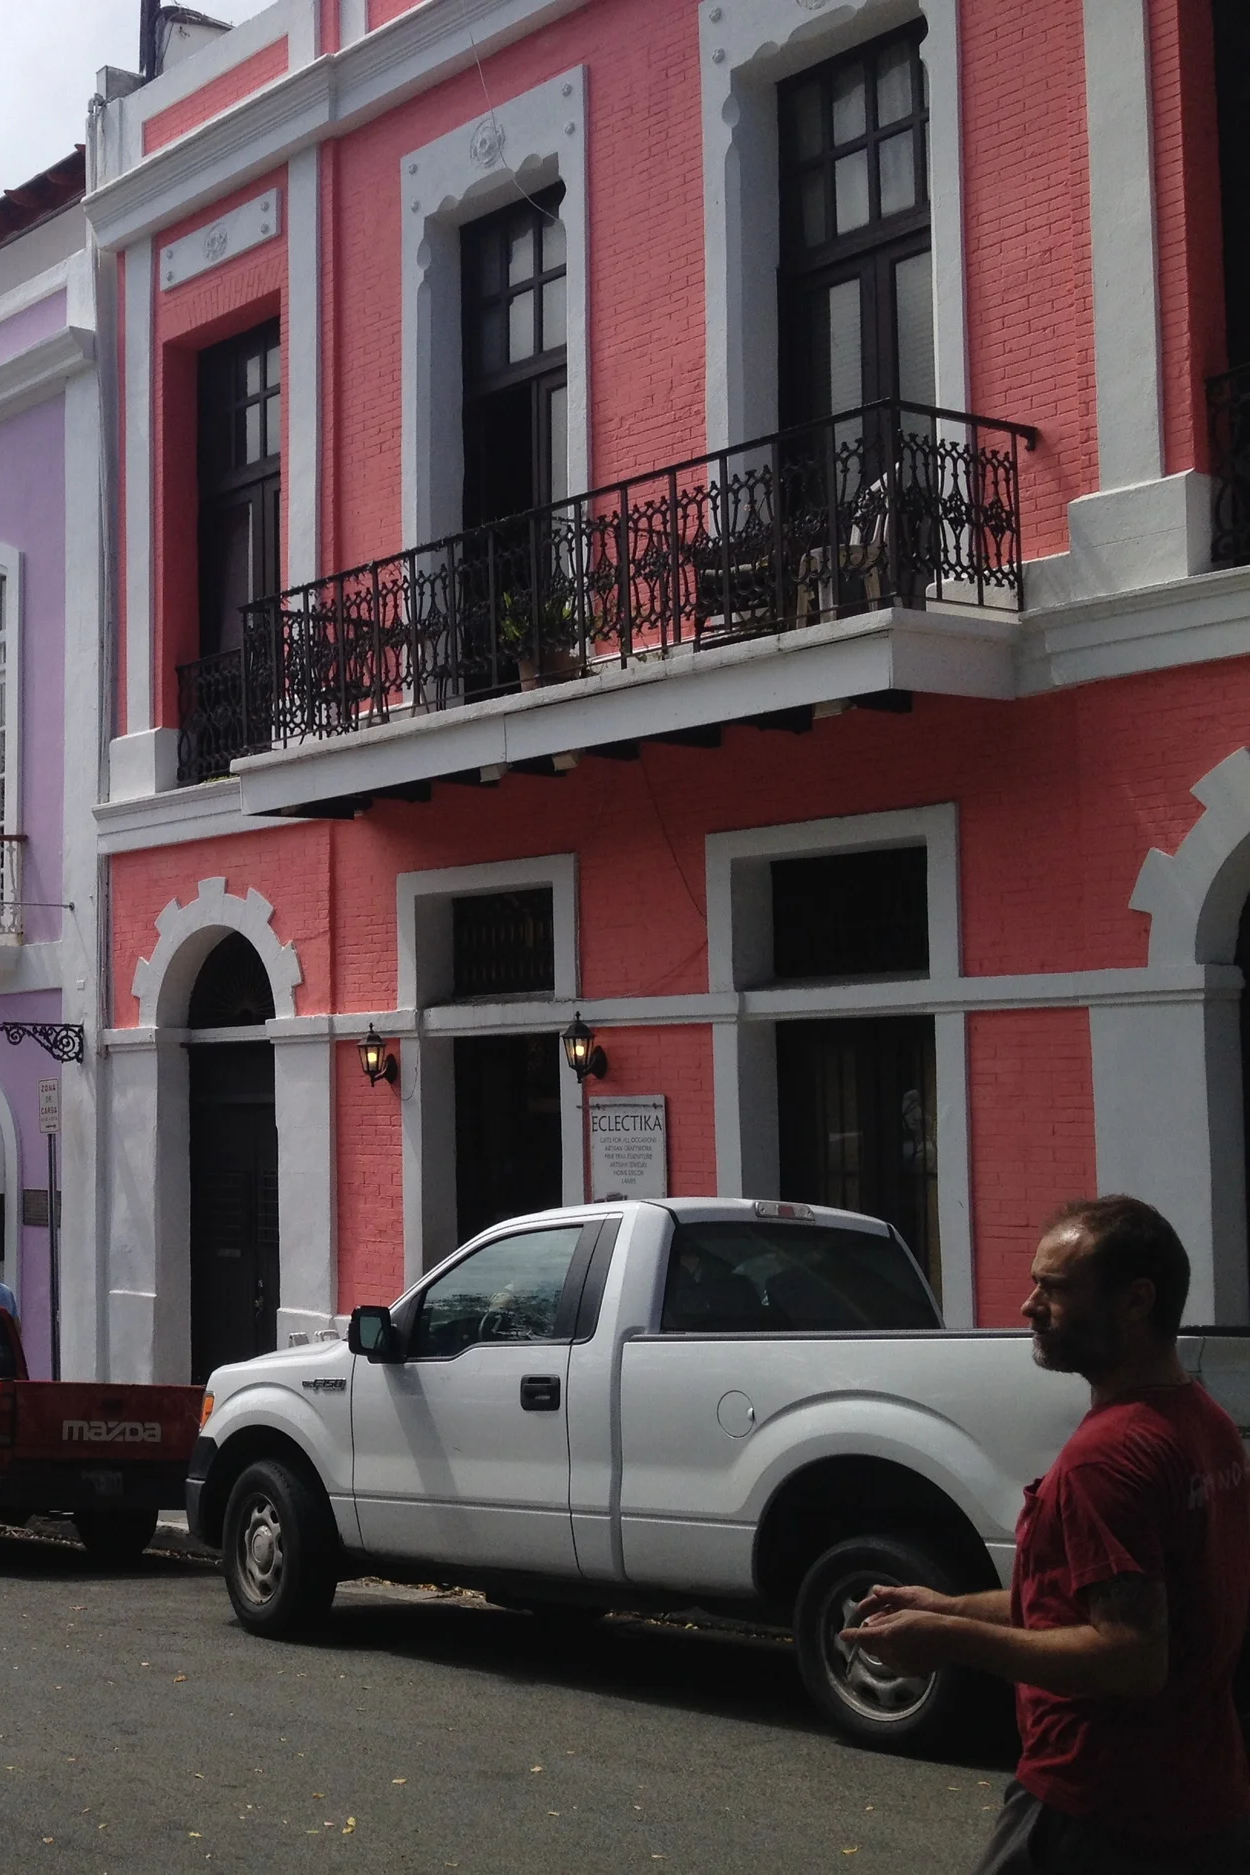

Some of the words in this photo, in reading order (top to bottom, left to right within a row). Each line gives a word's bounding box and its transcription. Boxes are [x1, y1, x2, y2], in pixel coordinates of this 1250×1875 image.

[41, 1084, 56, 1092] ZONA
[41, 1106, 57, 1115] CARGA
[592, 1115, 662, 1132] ECLECTIKA
